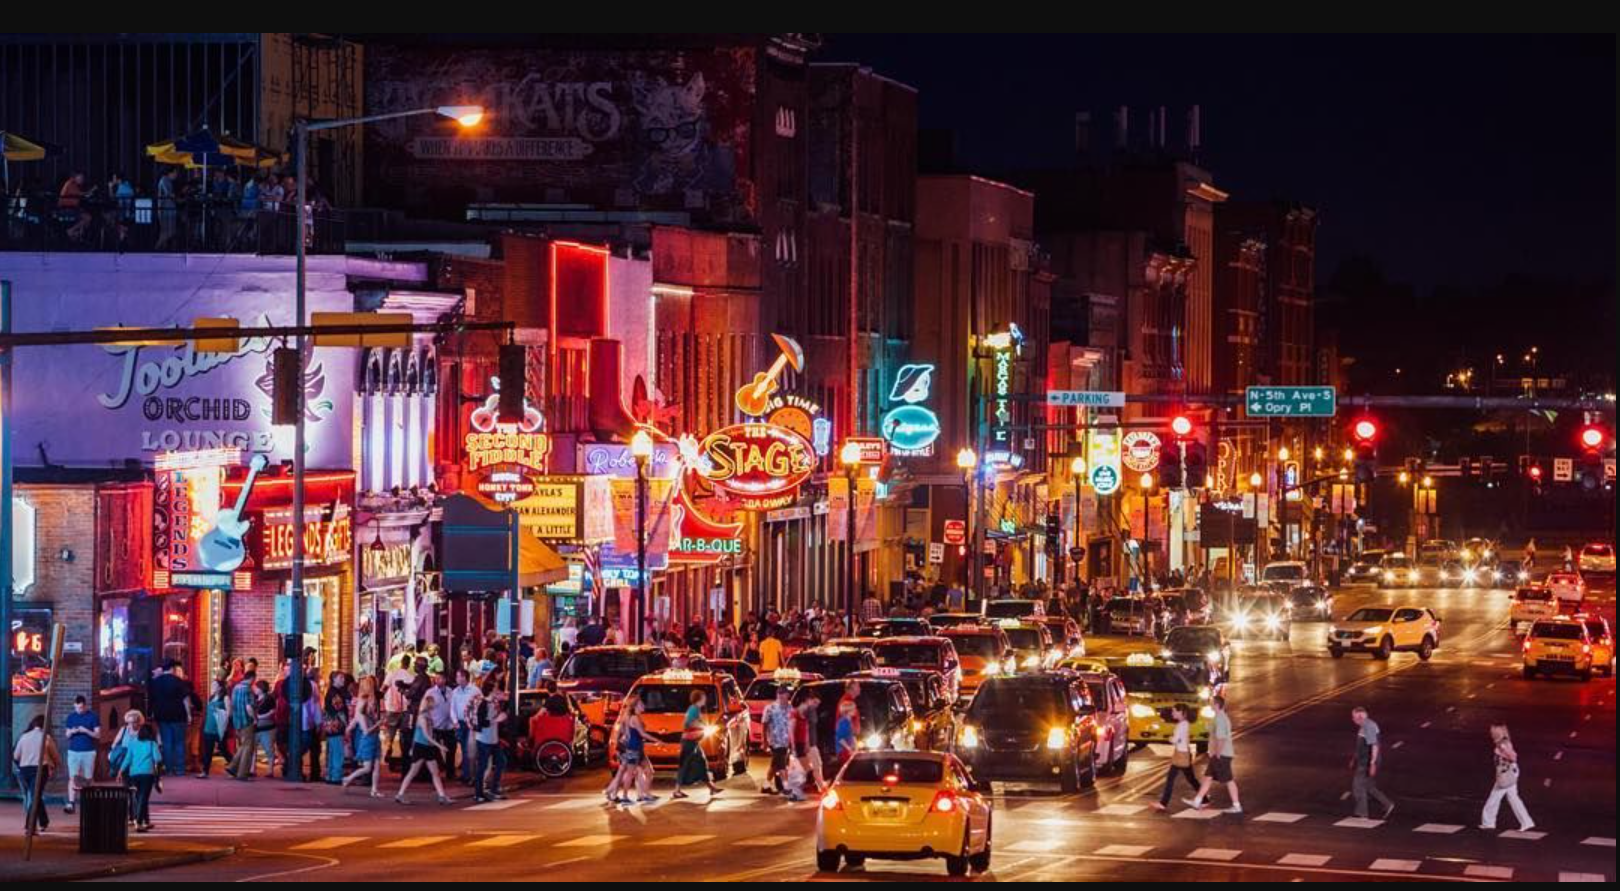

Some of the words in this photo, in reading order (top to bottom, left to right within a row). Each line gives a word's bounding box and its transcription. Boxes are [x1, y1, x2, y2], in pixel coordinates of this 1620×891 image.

[787, 395, 819, 414] TIME
[1062, 393, 1110, 404] PARKING
[1265, 403, 1292, 413] Opry
[143, 396, 251, 423] ORCHID
[141, 430, 274, 453] LOUNGE
[745, 427, 767, 438] THE
[465, 433, 547, 453] SECOND
[469, 448, 543, 471] FIDDLE
[704, 434, 810, 480] STAGE
[478, 483, 507, 492] HONKY
[509, 483, 533, 492] TONK
[534, 488, 563, 497] AYLA'S
[172, 471, 188, 571] LEGENDS
[546, 525, 571, 534] LITTLE
[271, 521, 323, 557] LEGNDS
[672, 537, 742, 553] AR-B-QUE
